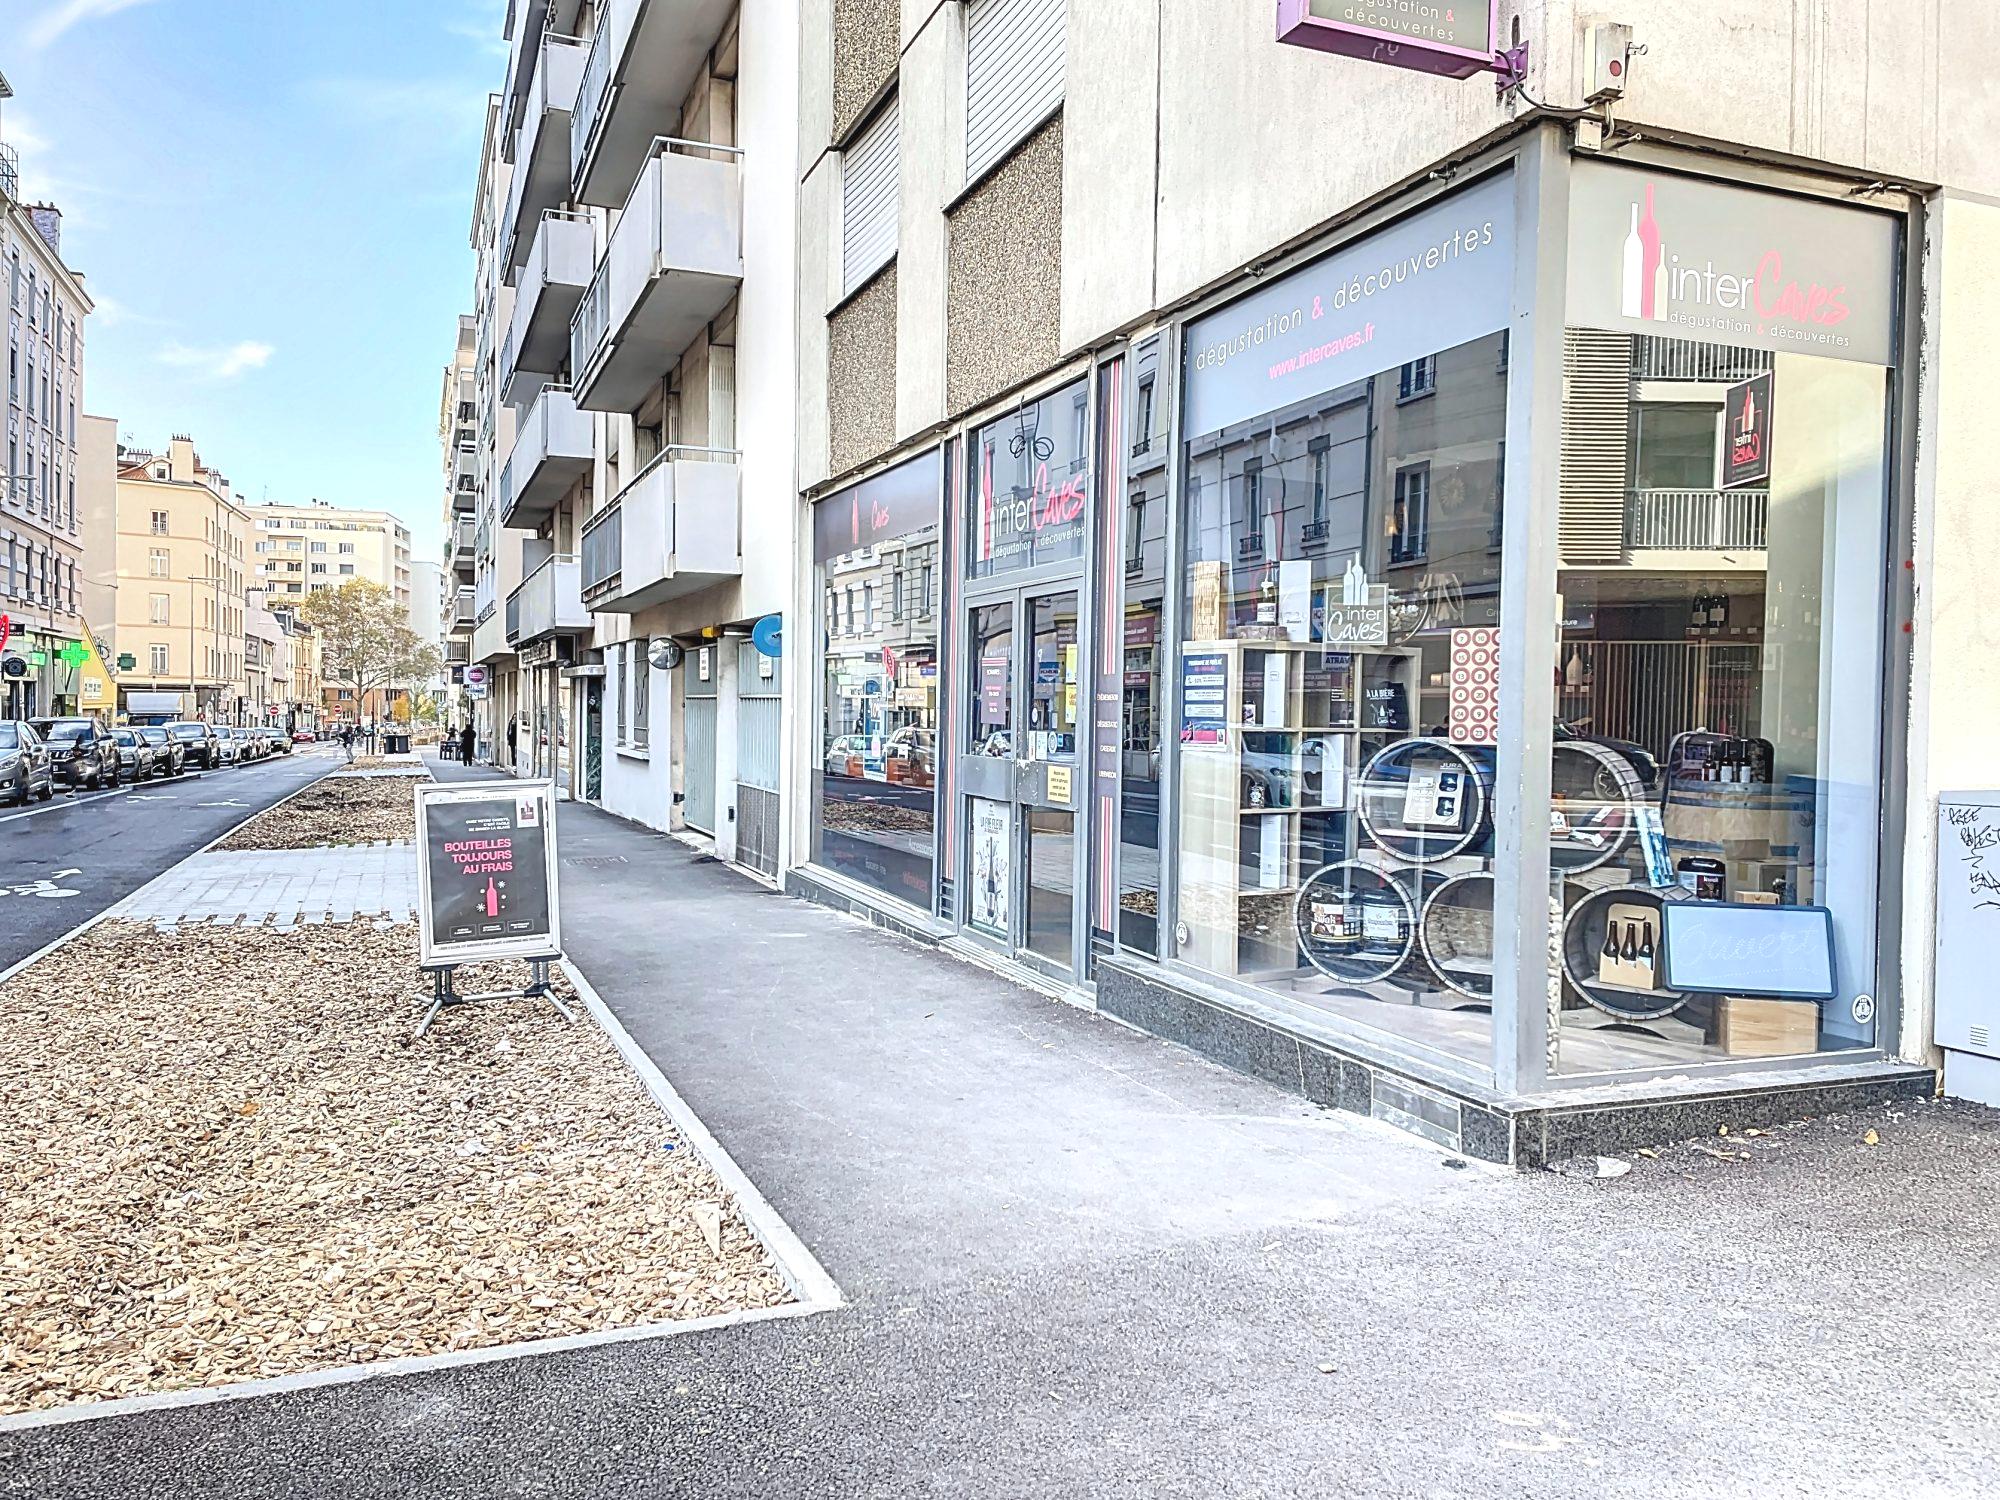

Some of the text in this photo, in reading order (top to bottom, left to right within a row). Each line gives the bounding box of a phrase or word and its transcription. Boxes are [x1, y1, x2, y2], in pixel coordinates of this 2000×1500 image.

[1344, 6, 1454, 41] découvertes
[1445, 9, 1454, 22] &
[1196, 221, 1494, 370] dégustation & découvertes
[1670, 310, 1752, 333] dégustation
[1770, 324, 1850, 347] découvertes
[1268, 322, 1376, 380] www.intercaves.fr
[871, 500, 889, 531] Caves
[995, 540, 1031, 558] dégustation
[1040, 526, 1085, 546] découvertes
[1328, 611, 1383, 640] Caves
[1347, 607, 1383, 621] inter
[444, 838, 512, 852] BOUTEILLES
[452, 850, 512, 864] TOUJOURS
[463, 861, 513, 875] AU FRAIS
